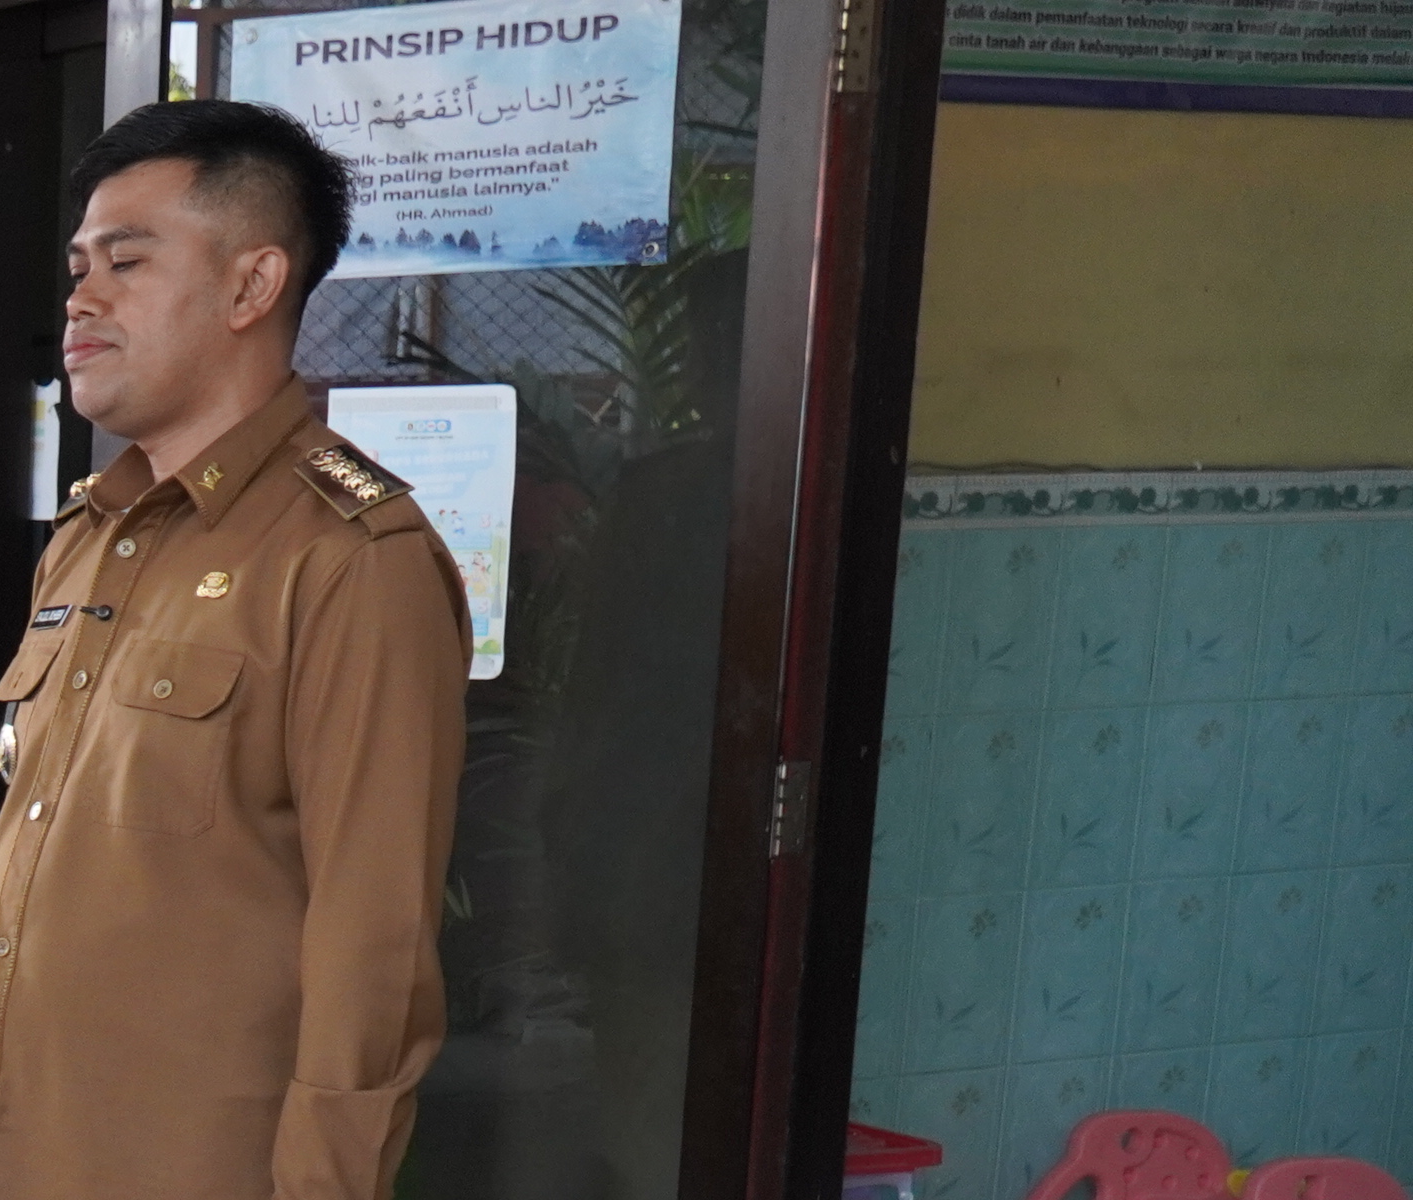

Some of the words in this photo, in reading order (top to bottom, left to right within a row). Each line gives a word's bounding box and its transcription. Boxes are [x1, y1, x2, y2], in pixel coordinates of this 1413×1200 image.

[989, 6, 1032, 22] dalam
[1036, 11, 1124, 28] pemanfaatan
[1126, 14, 1188, 34] teknologi
[1280, 22, 1301, 37] dan
[1304, 23, 1368, 40] produktif
[1371, 24, 1412, 40] dalam
[294, 29, 464, 67] PRINSIP
[475, 14, 620, 52] HIDUP
[948, 33, 982, 48] cinta
[986, 34, 1025, 50] tanah
[1028, 35, 1048, 51] air
[1050, 36, 1075, 52] dan
[1079, 38, 1159, 59] kebanggaan
[1162, 43, 1212, 62] sebagai
[1255, 49, 1298, 65] negara
[1301, 49, 1369, 64] Indonesia
[347, 149, 428, 169] aik-baik
[434, 143, 520, 163] manusia
[525, 138, 598, 157] adalah
[379, 166, 443, 188] paling
[448, 158, 570, 181] bermanfaat
[383, 184, 468, 202] manusia
[396, 209, 428, 222] (HR.
[431, 204, 494, 220] Ahmad)
